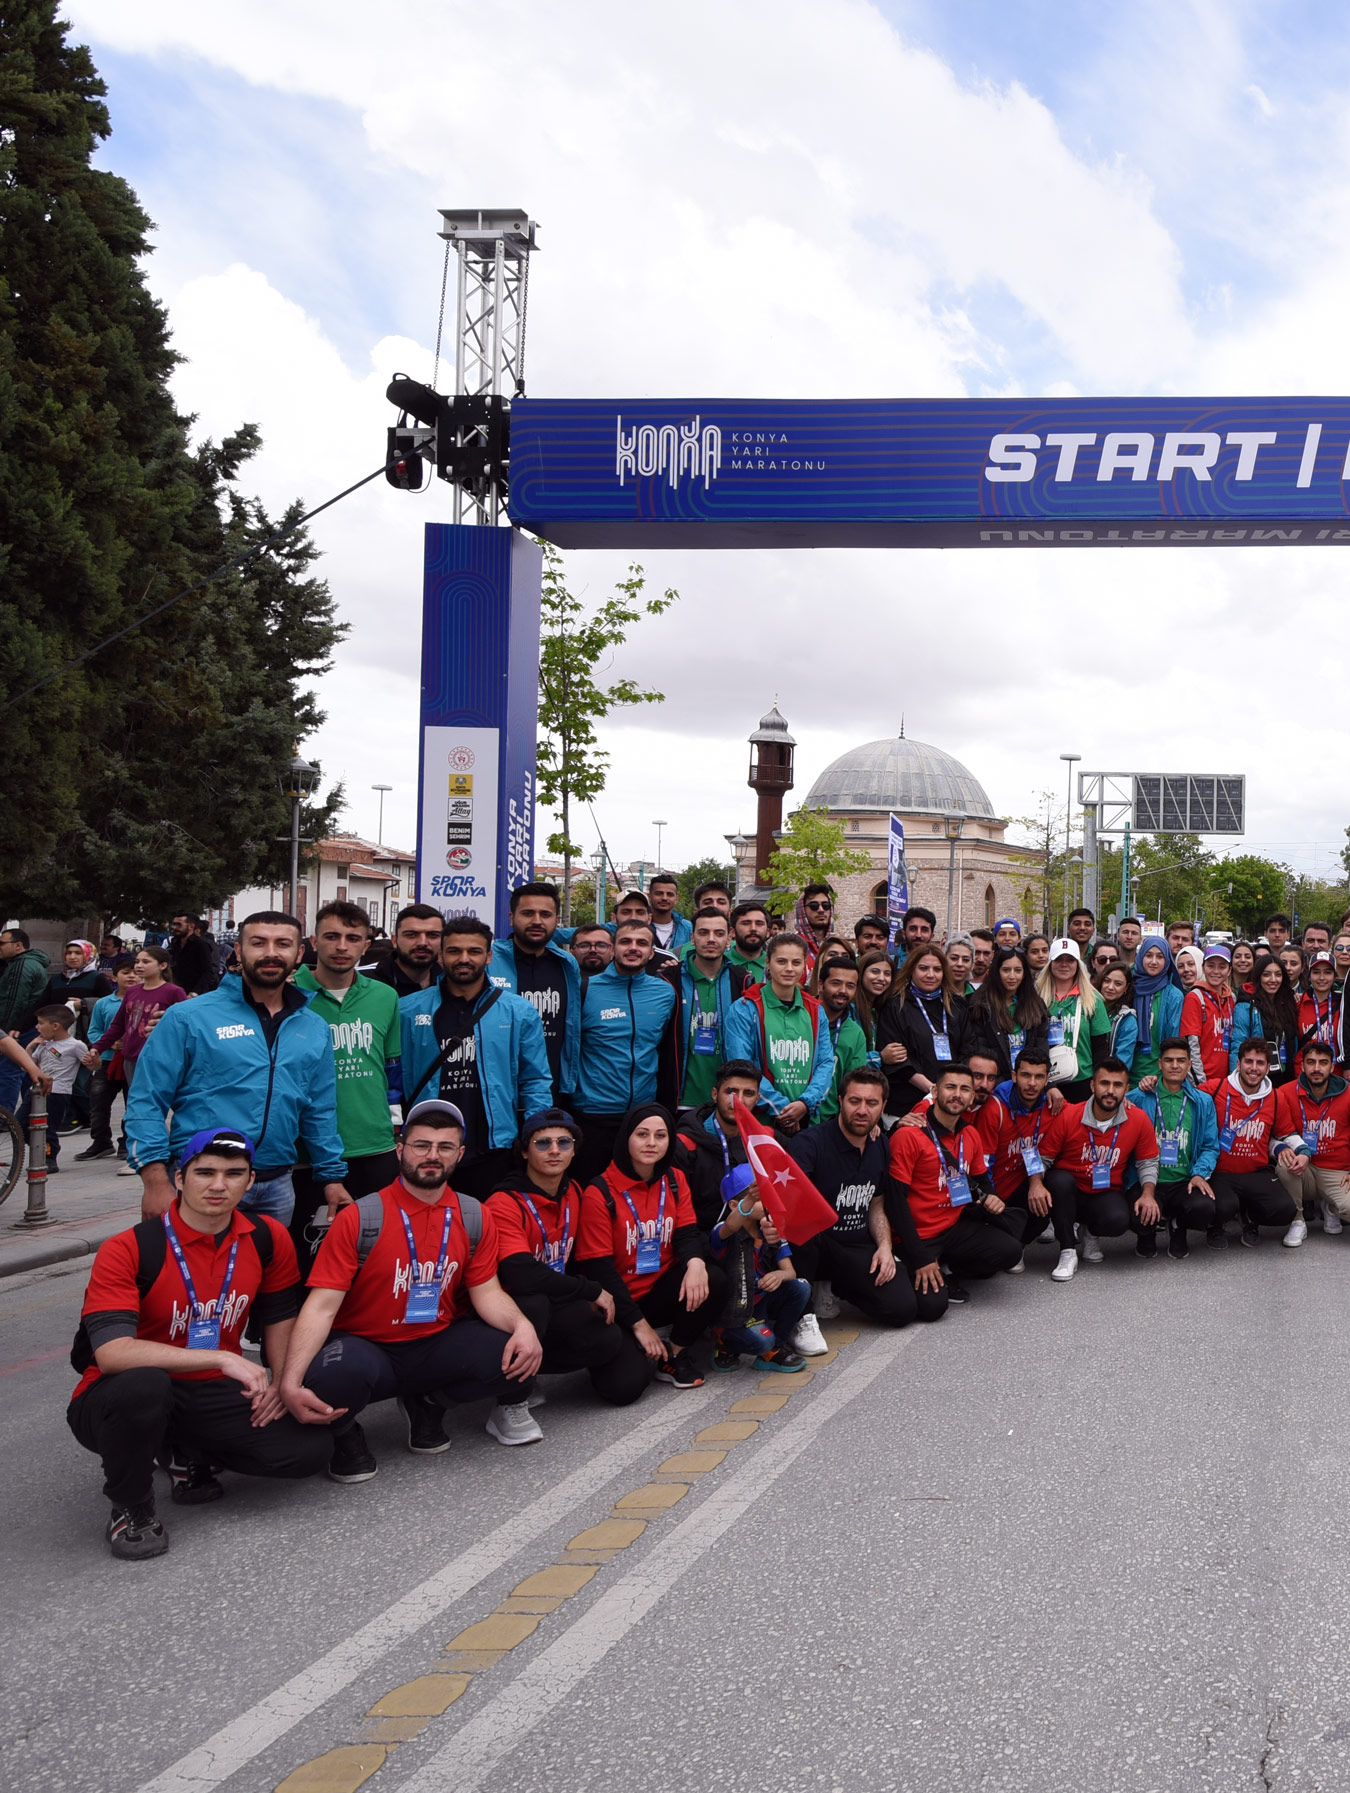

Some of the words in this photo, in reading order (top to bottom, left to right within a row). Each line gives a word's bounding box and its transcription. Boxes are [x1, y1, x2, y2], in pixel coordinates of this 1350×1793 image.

[732, 433, 788, 443] KONYA
[732, 446, 769, 456] YARI
[985, 431, 1277, 482] START
[732, 460, 826, 470] MARATONU
[980, 529, 1303, 541] MARATONU
[522, 770, 532, 886] RATONU
[507, 798, 518, 892] KONYA
[515, 814, 524, 877] YARI
[431, 875, 475, 887] SPOR
[431, 884, 486, 897] KONYA
[216, 1024, 245, 1035] SPOR
[218, 1028, 255, 1040] KONYA
[337, 1070, 374, 1080] RATONU
